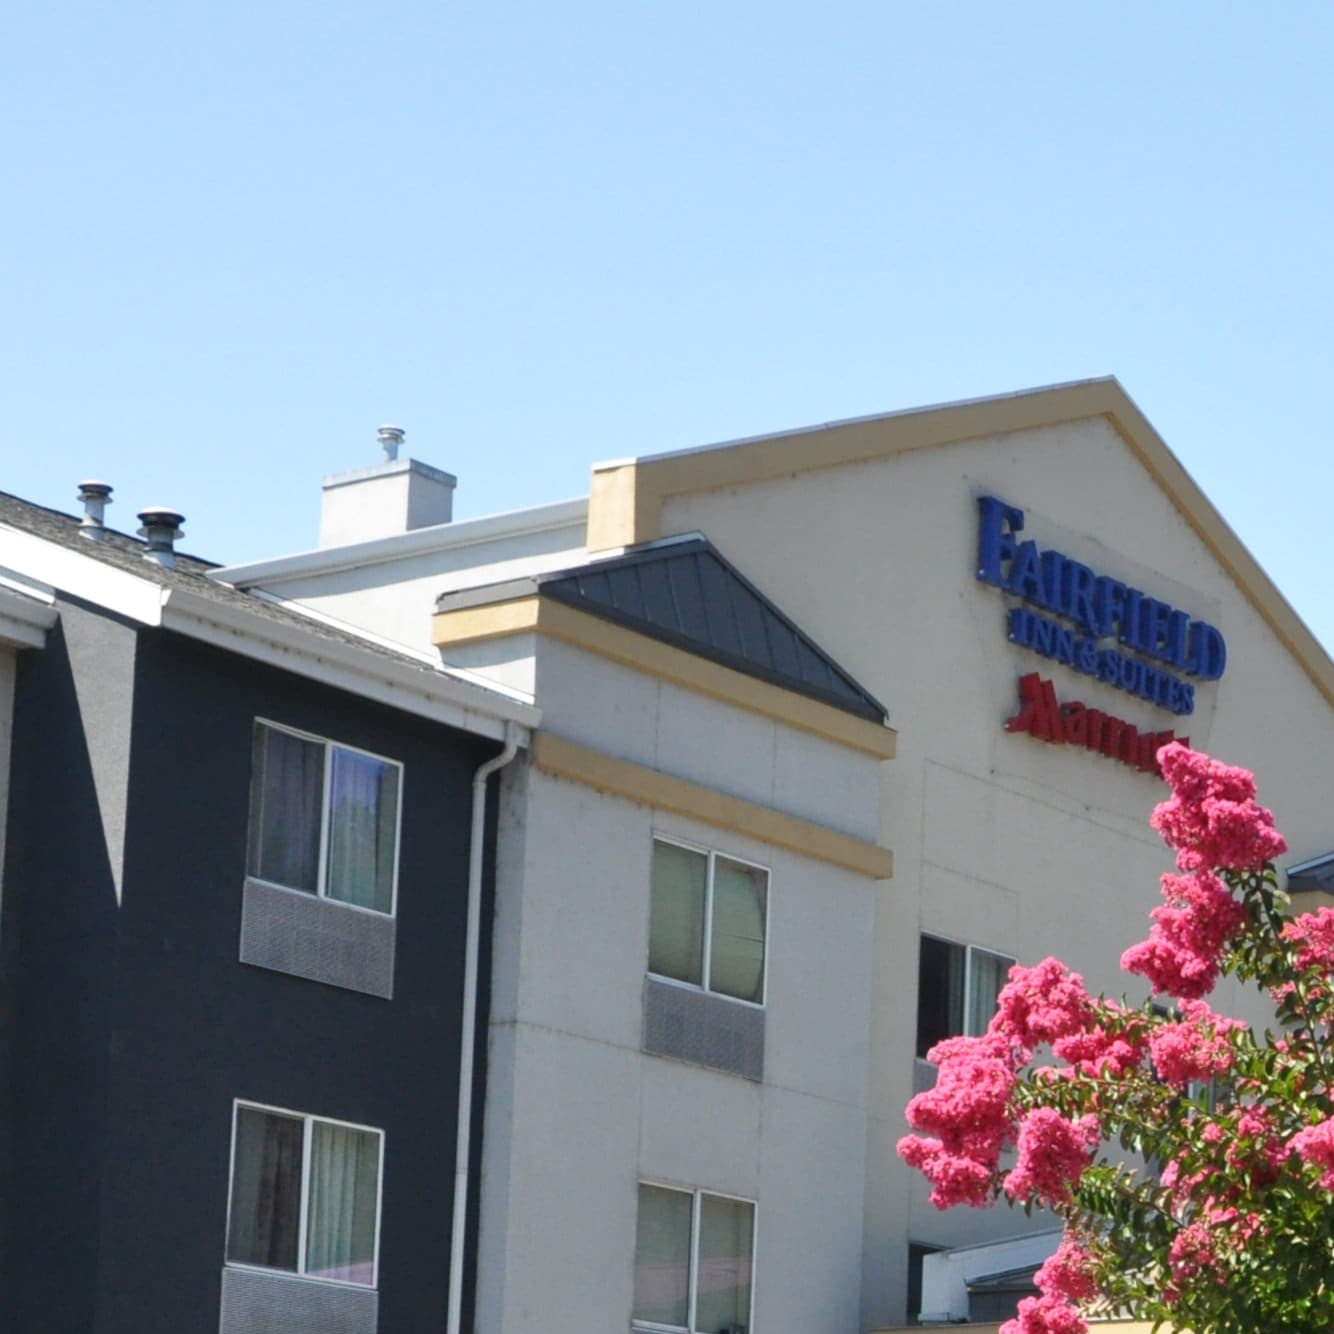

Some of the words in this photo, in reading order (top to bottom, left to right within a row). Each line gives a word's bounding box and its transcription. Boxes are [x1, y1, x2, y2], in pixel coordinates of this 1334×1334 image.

[976, 496, 1226, 681] FAIRFIELD
[1006, 607, 1076, 667] INN
[1103, 649, 1195, 715] SUITES
